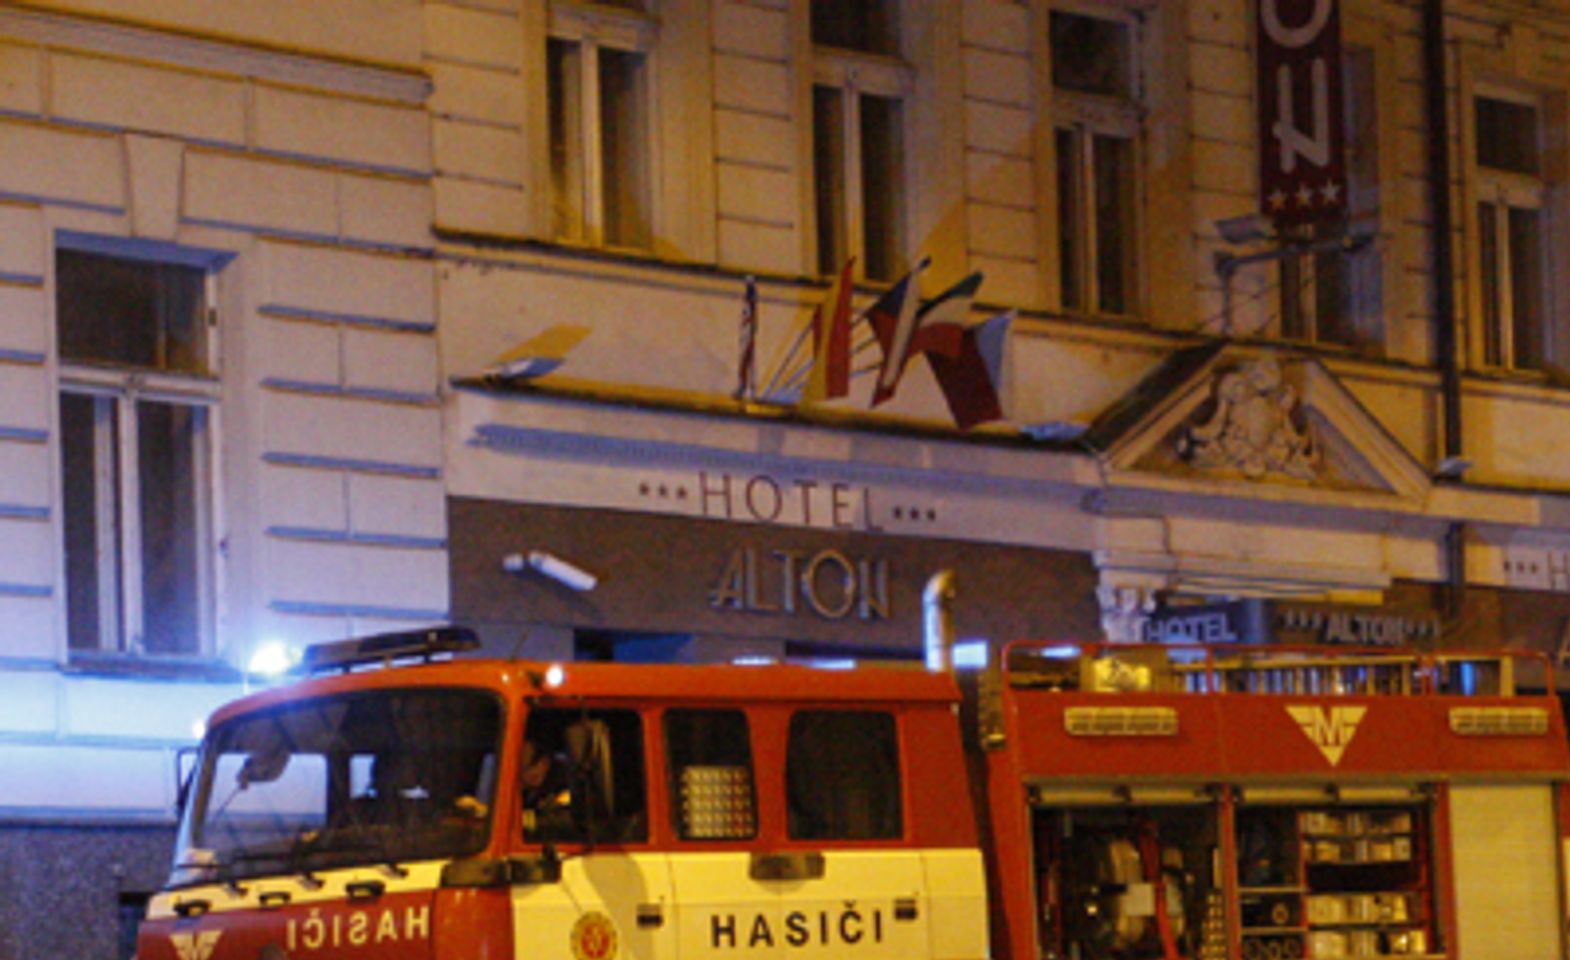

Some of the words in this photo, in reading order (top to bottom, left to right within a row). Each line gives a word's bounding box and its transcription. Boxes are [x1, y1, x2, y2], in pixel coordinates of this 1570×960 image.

[701, 472, 884, 532] HOTEL
[710, 546, 892, 620] ALTON
[1146, 611, 1239, 643] HOTEL
[711, 900, 882, 948] HASIČI
